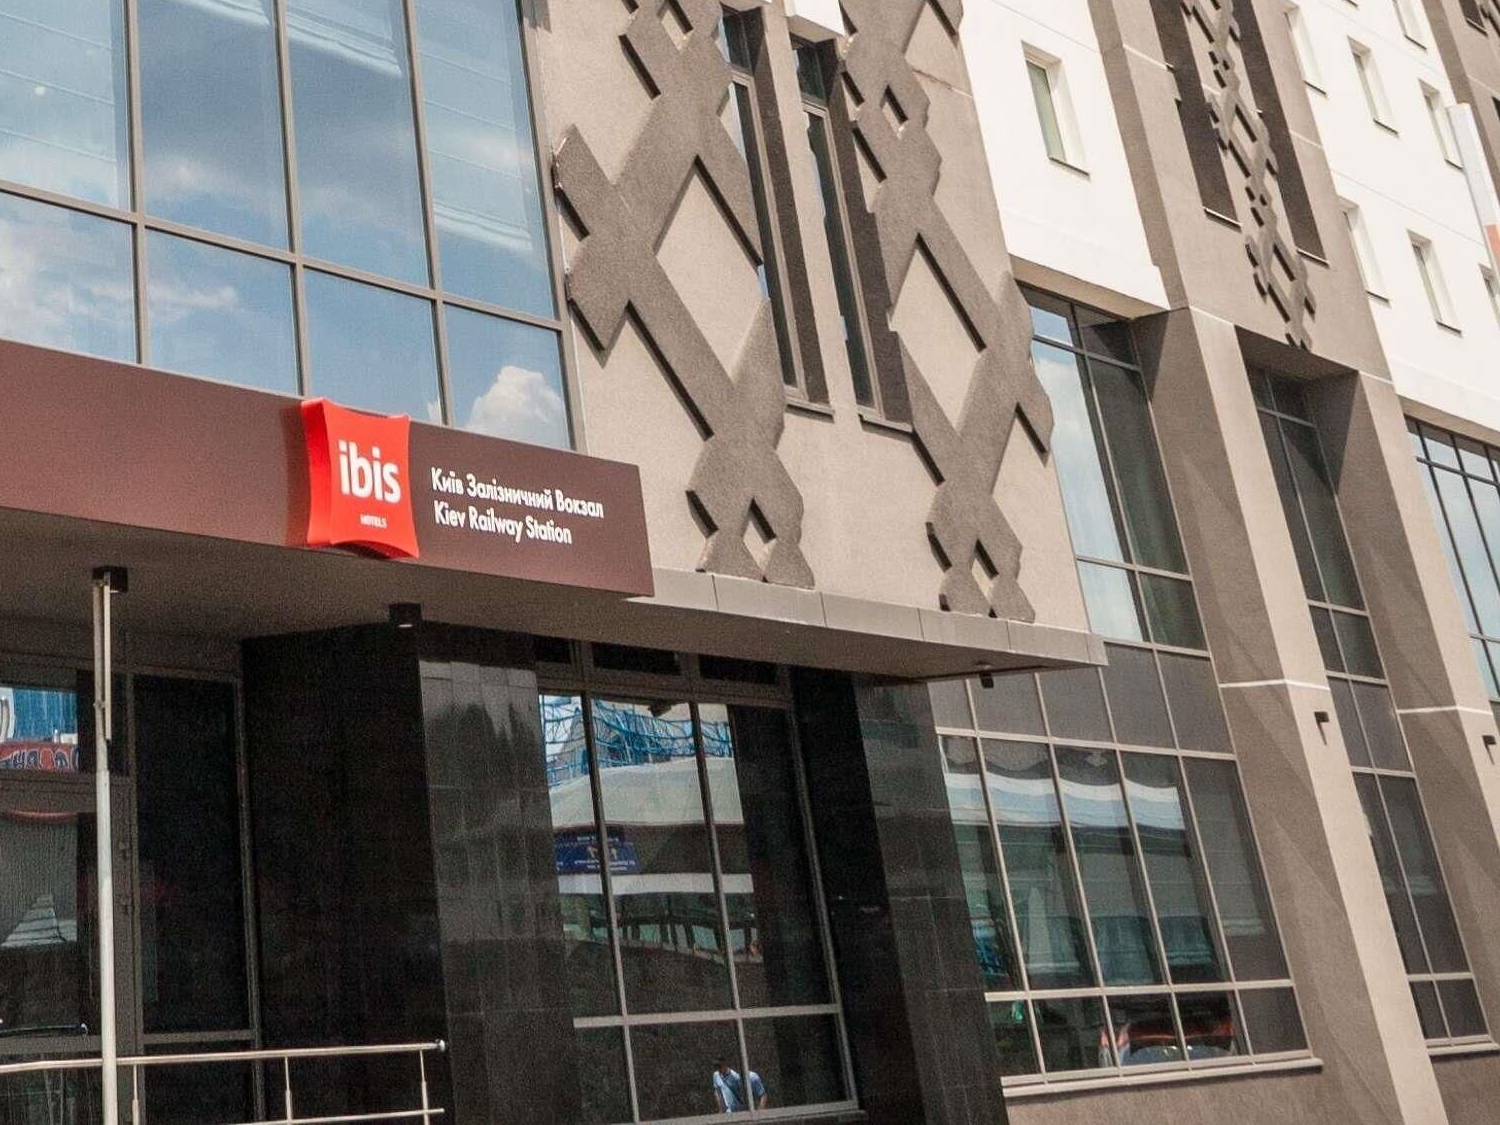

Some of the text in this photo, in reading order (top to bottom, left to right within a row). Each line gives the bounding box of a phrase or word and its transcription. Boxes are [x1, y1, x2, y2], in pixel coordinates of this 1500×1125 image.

[338, 439, 401, 504] ibis
[431, 466, 604, 518] Київ Залізничний Вокзал
[433, 500, 573, 544] Kiev Railway Station
